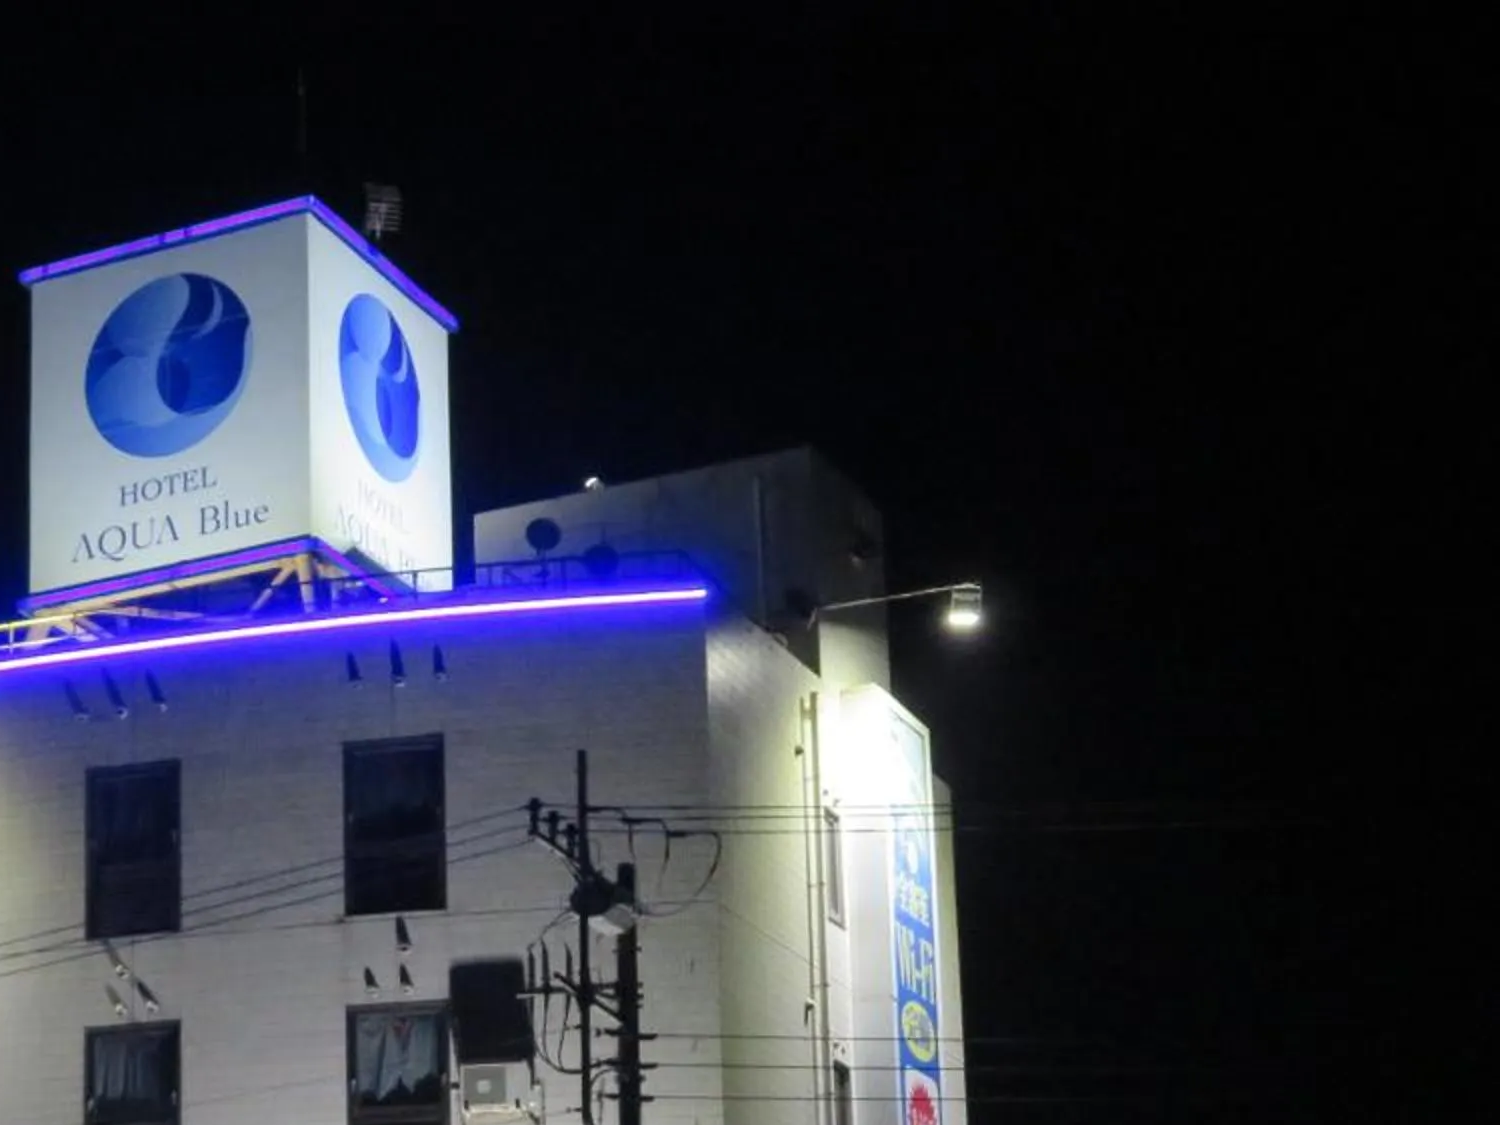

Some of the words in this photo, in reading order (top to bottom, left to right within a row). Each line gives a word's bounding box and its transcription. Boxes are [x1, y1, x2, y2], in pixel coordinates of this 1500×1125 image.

[119, 466, 218, 507] HOTEL
[71, 513, 181, 563] AQUA
[199, 499, 270, 537] Blue
